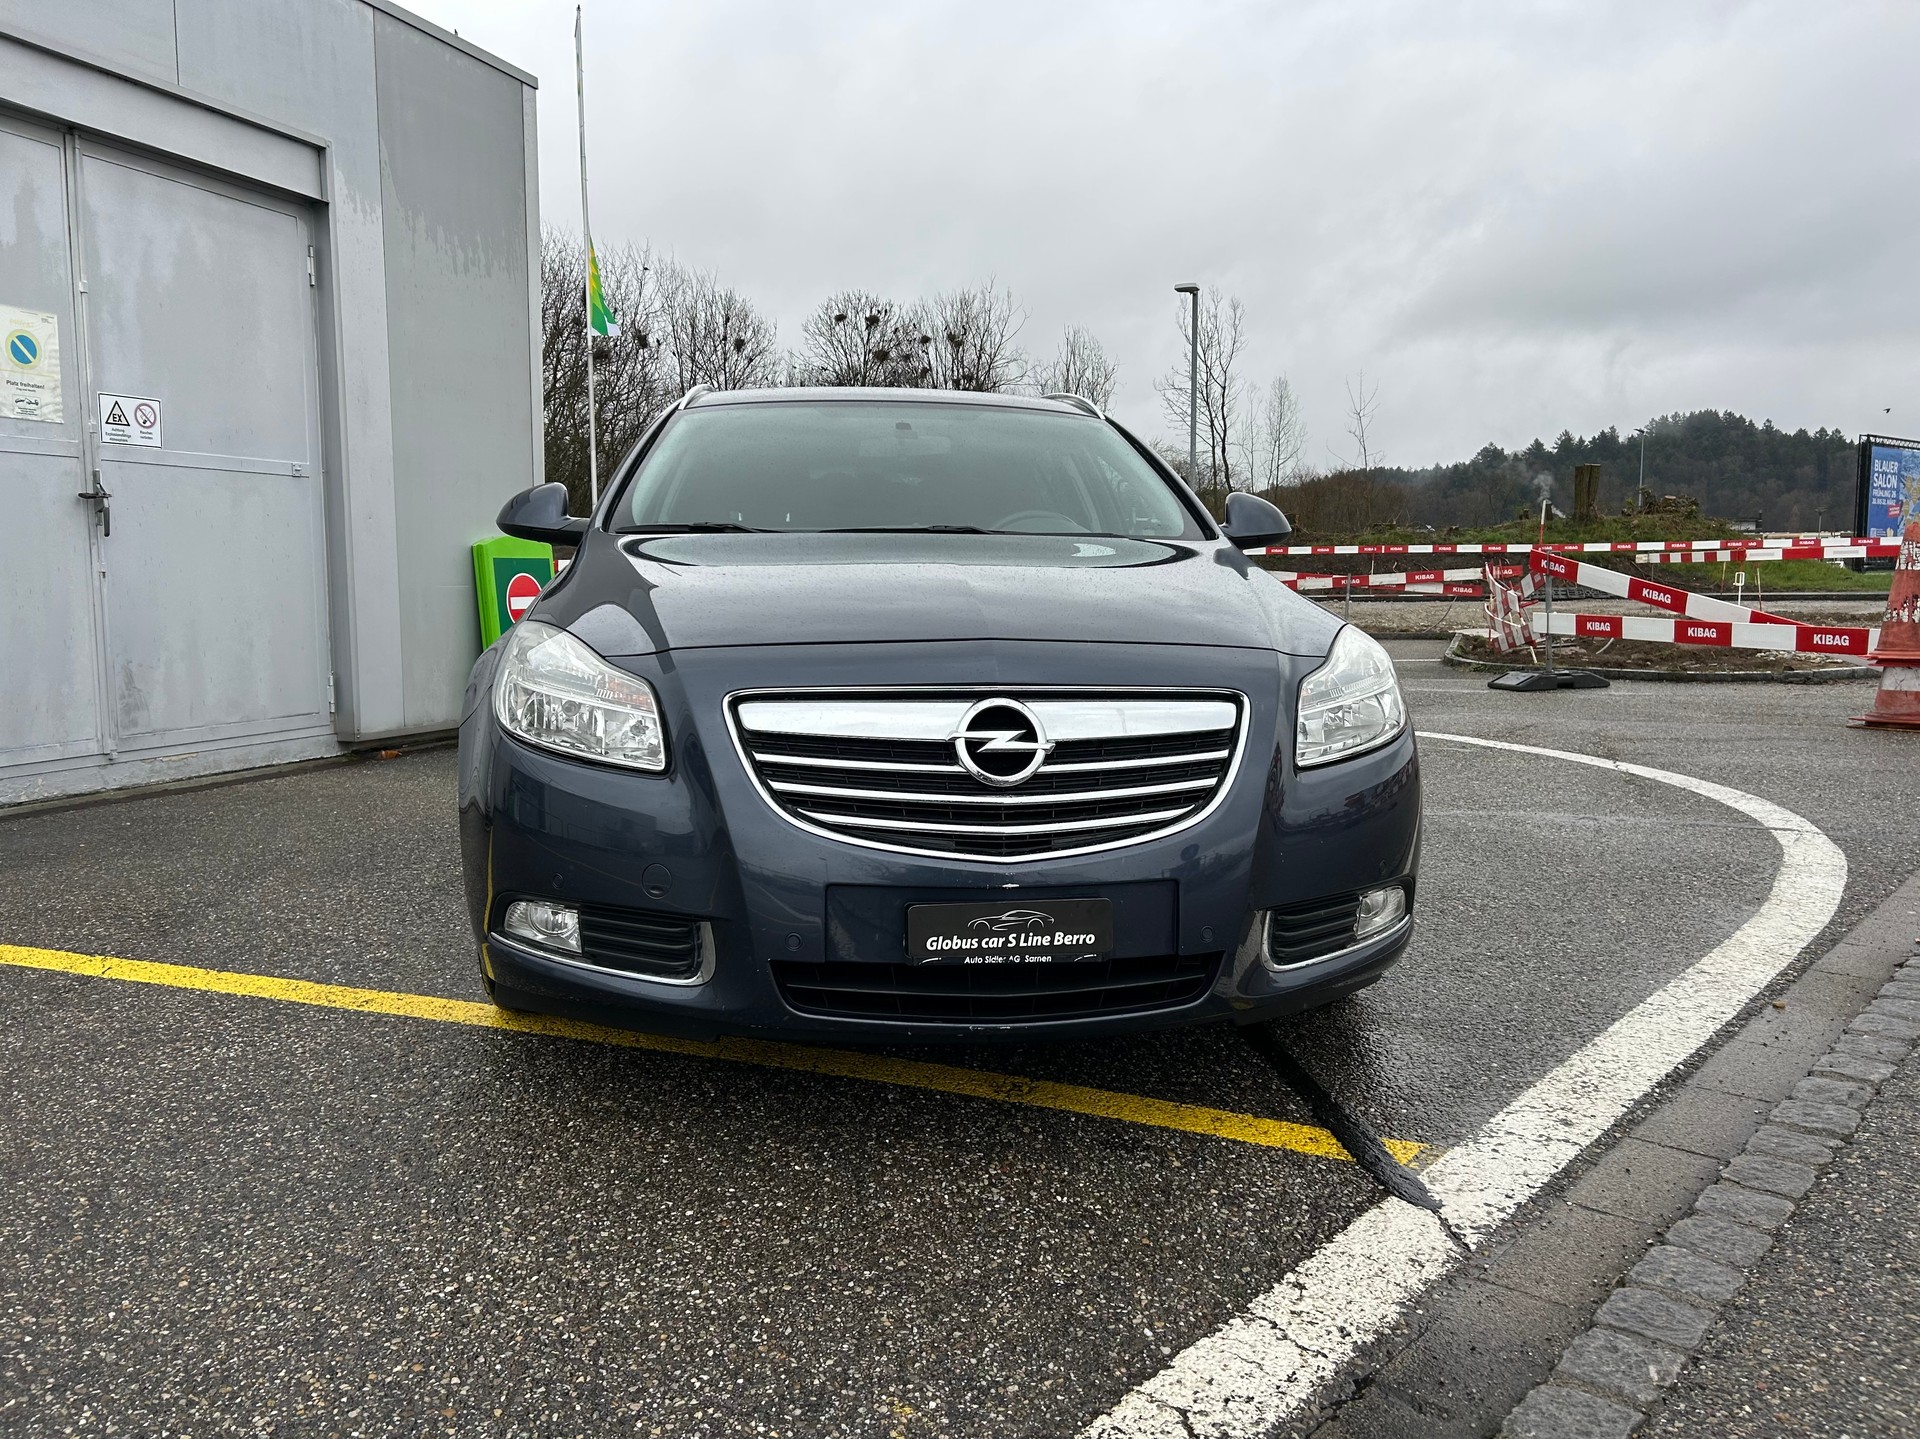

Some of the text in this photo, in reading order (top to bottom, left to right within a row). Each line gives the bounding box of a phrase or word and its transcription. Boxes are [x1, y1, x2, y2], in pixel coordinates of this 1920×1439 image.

[112, 413, 123, 423] EX
[1874, 459, 1898, 473] BLAUER
[1873, 473, 1898, 489] SALON
[1541, 559, 1565, 573] KBAG
[1642, 587, 1671, 604] KIBAG
[1586, 621, 1611, 632] KIBAG
[1687, 626, 1717, 638] KIBAG
[1813, 633, 1850, 646] KIBAG
[926, 931, 1096, 951] Globus car S Line Berro
[964, 956, 983, 964] Auto
[1024, 954, 1052, 963] Sarnen
